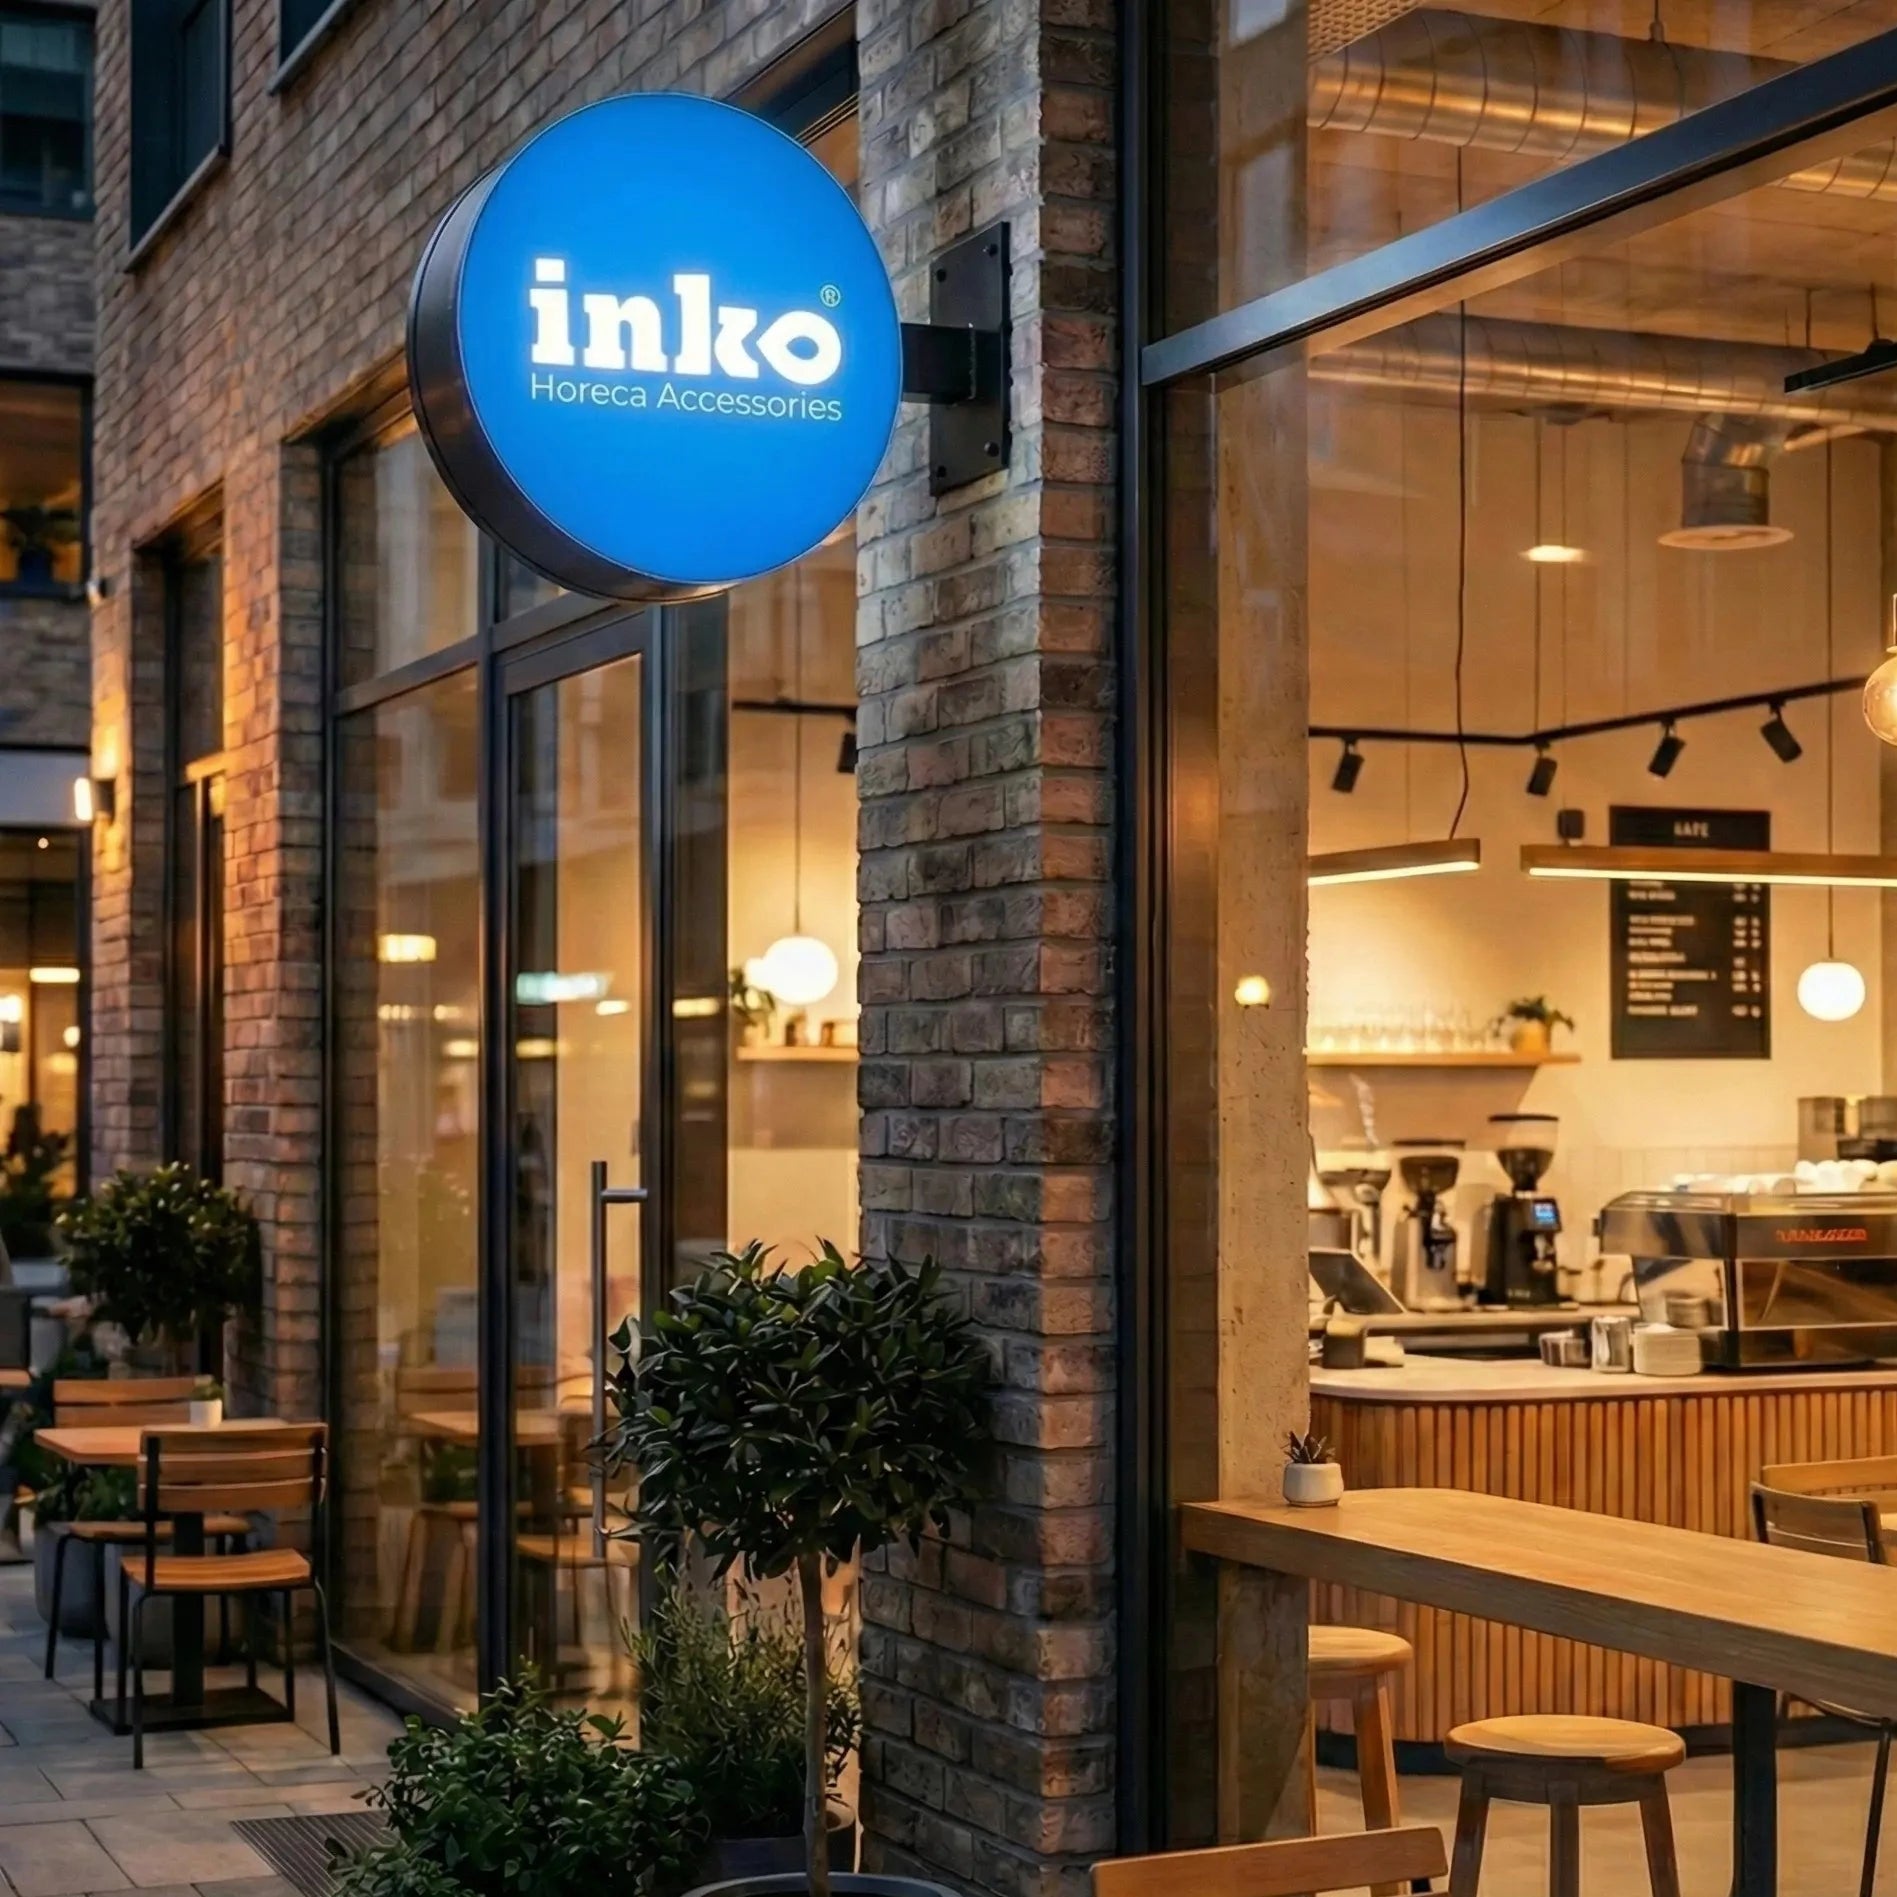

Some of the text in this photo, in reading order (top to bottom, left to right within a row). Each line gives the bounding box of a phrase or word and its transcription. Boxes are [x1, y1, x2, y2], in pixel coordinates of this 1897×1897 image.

[529, 257, 842, 386] inko
[531, 373, 842, 421] Horeca Accessories
